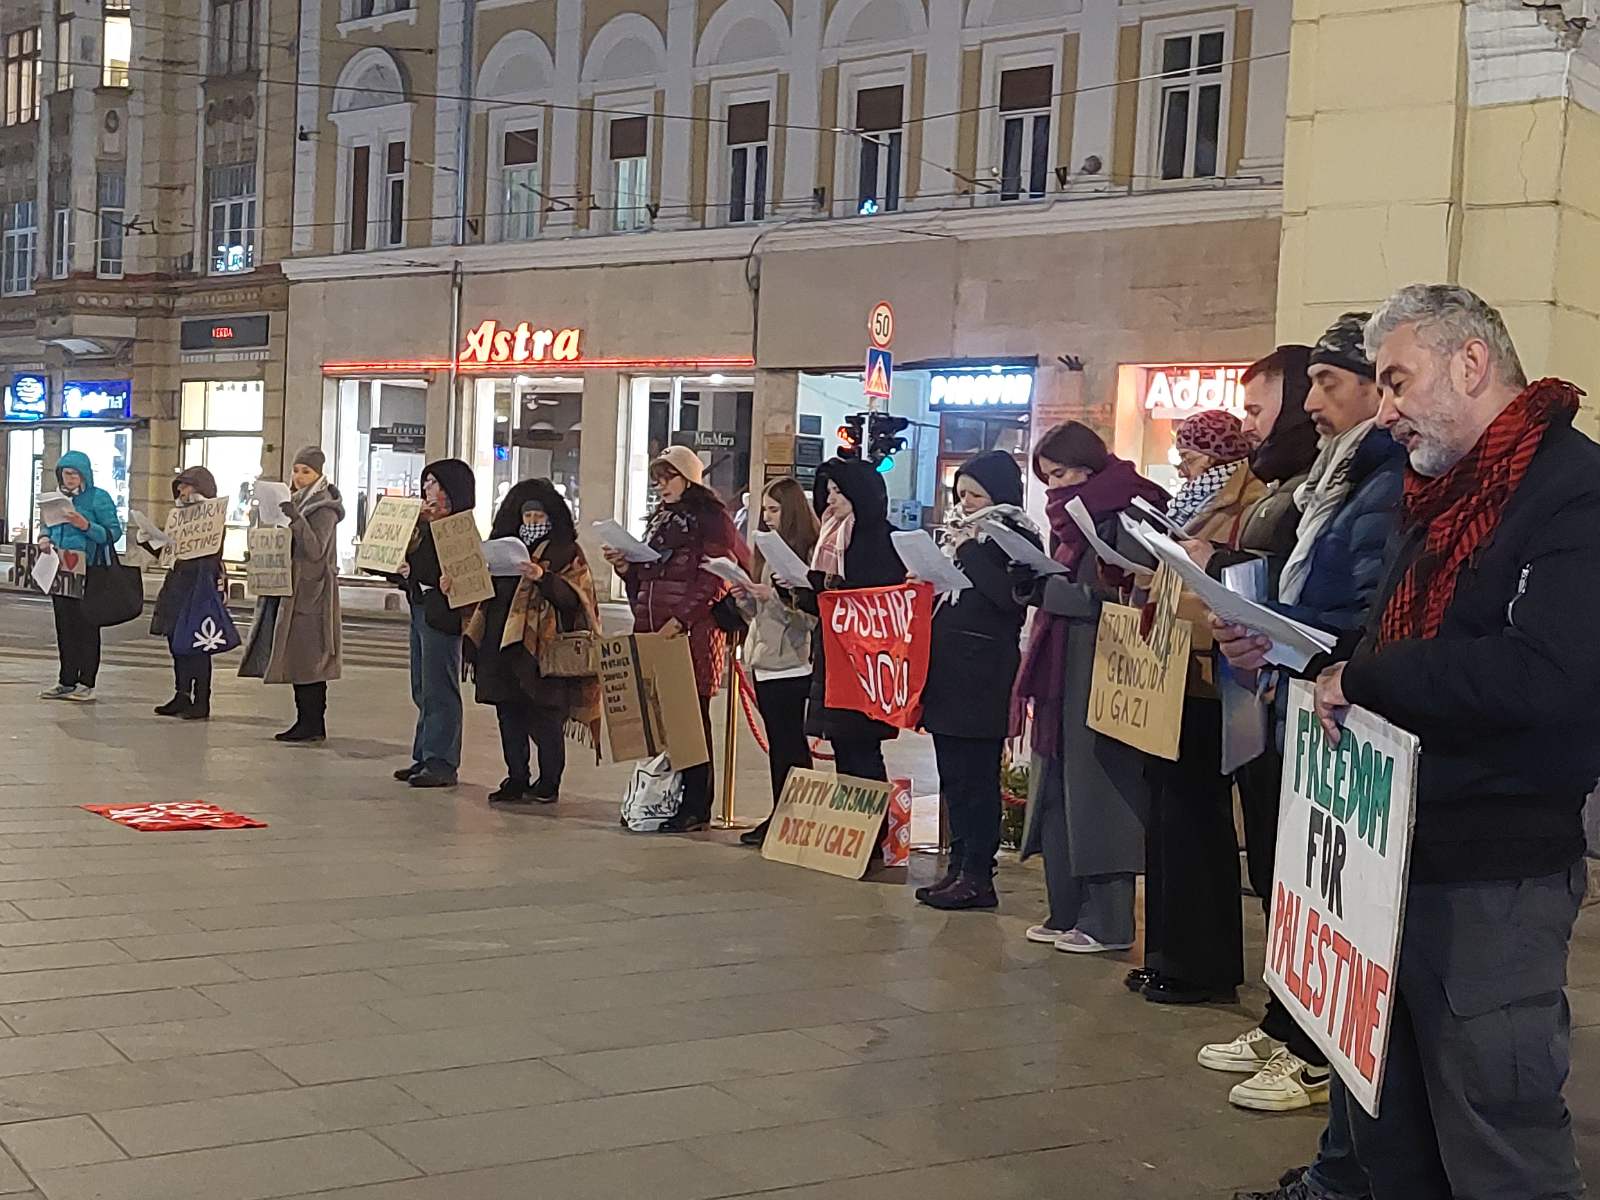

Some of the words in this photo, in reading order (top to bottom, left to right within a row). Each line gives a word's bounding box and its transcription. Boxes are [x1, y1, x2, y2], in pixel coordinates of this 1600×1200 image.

[459, 320, 581, 362] Astra
[875, 313, 890, 337] 50
[601, 642, 622, 658] NO
[1094, 688, 1105, 722] U
[1111, 690, 1149, 729] GAZI
[784, 776, 834, 806] PROTIV
[829, 783, 889, 820] UBIJANJA
[1294, 707, 1394, 858] FREEDOM
[778, 816, 816, 847] DJECE
[815, 823, 827, 848] U
[825, 825, 866, 859] GAZI
[1306, 805, 1347, 921] FOR
[1271, 880, 1389, 1084] PALESTINE
